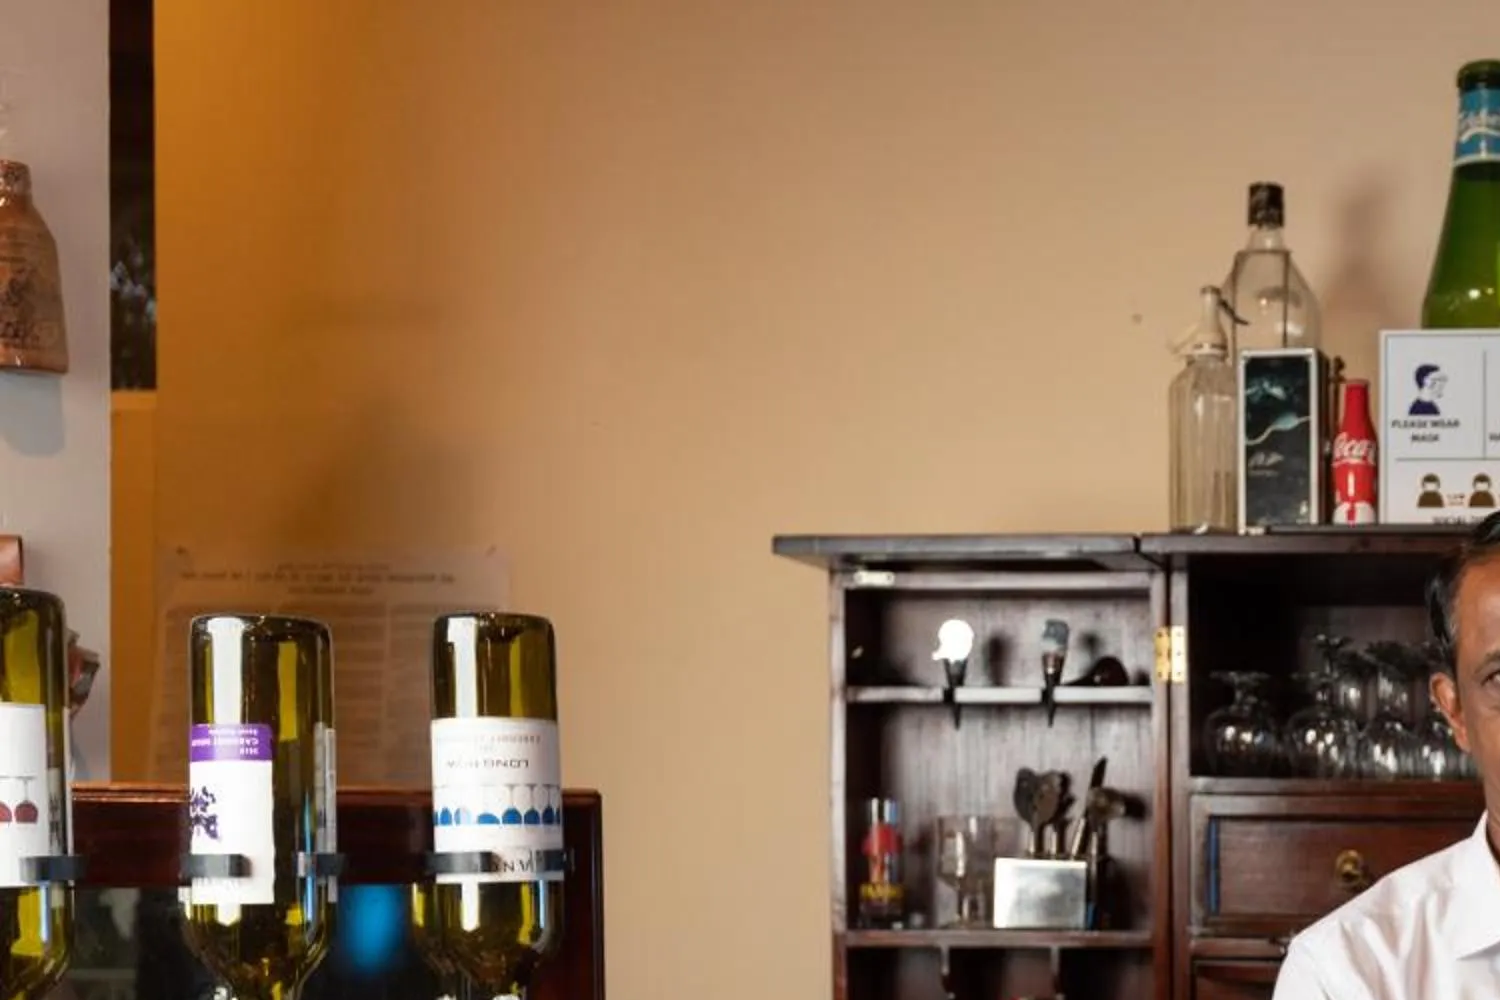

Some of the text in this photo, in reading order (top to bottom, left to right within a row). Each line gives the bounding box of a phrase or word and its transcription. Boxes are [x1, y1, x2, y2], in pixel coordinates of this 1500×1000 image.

[1391, 419, 1460, 429] PLEASE WEAR
[1411, 434, 1440, 443] MASK
